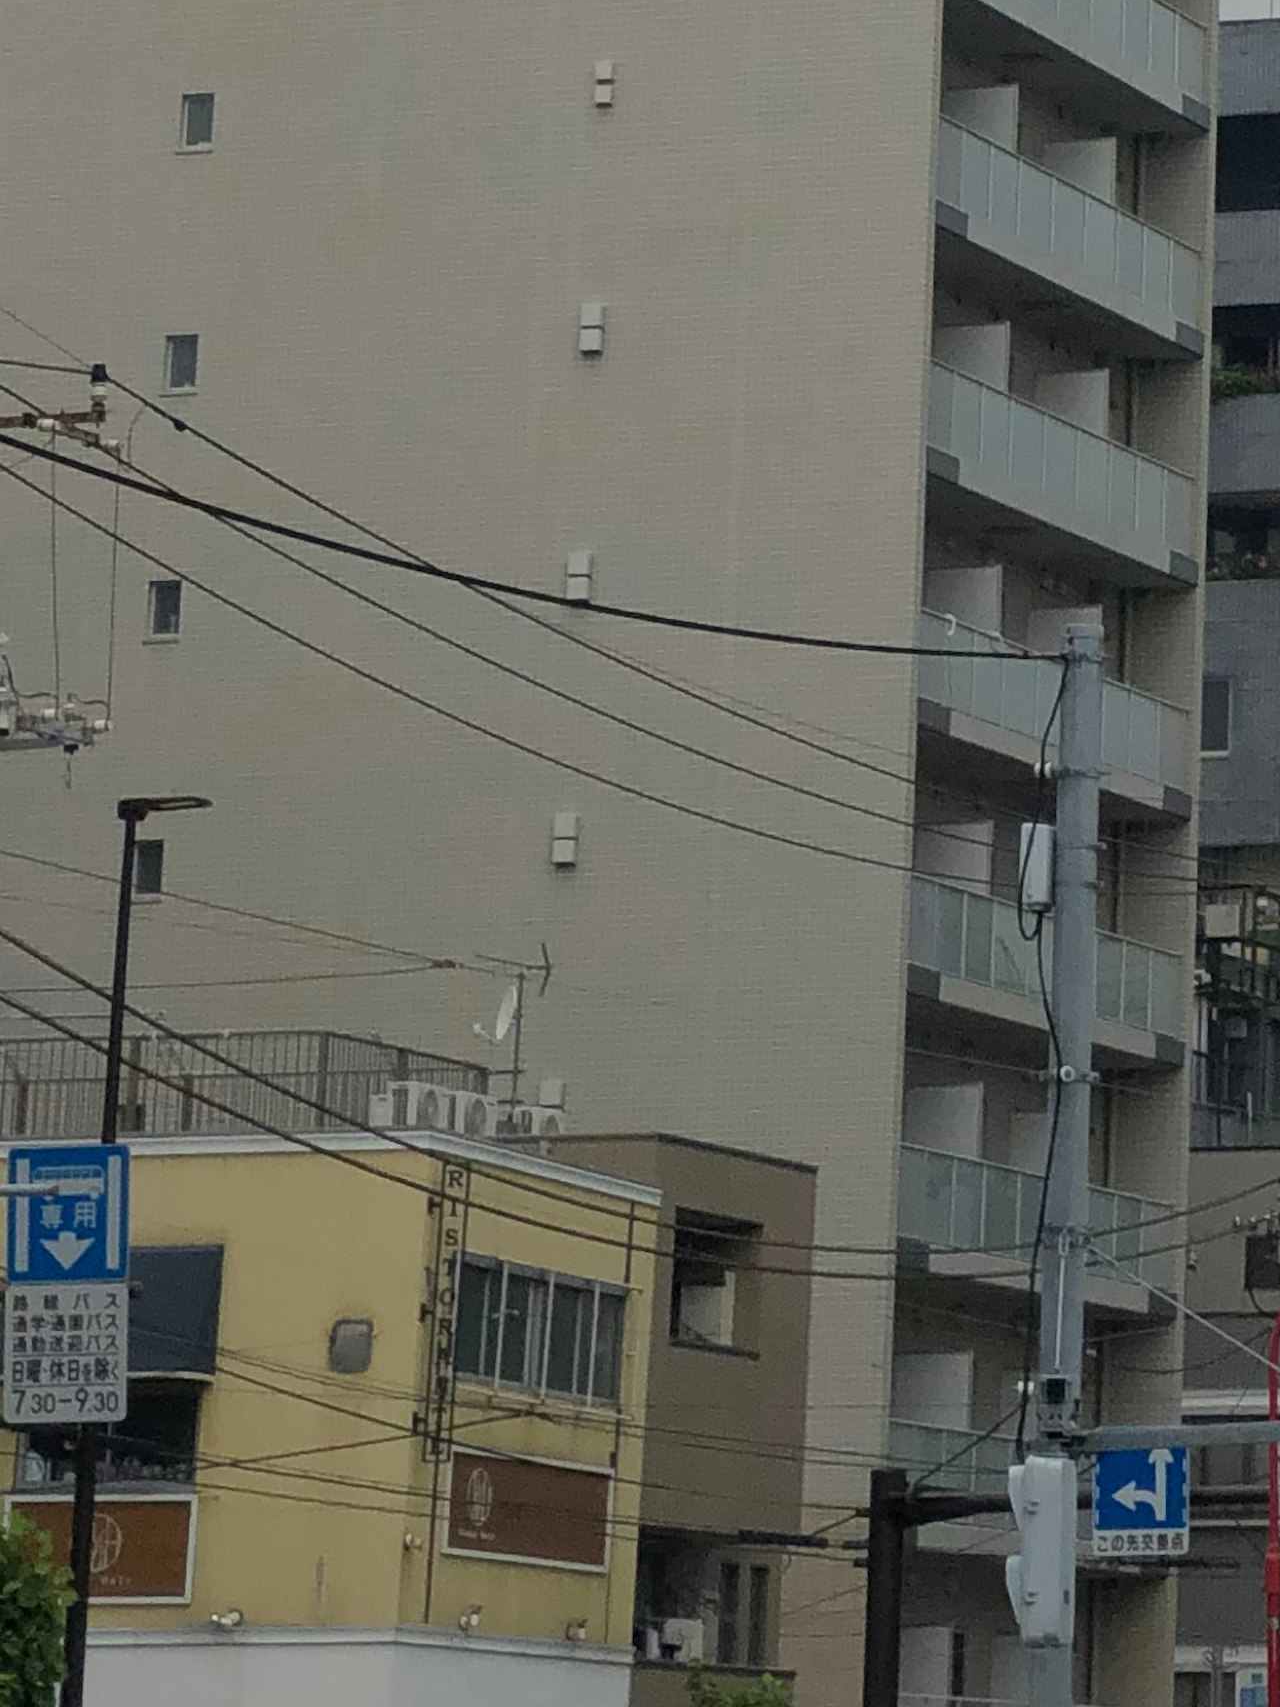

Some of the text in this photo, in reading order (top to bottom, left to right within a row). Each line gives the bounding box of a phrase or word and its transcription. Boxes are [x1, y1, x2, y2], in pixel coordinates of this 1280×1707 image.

[39, 1201, 97, 1229] 専用
[1096, 1533, 1185, 1552] この先交差点
